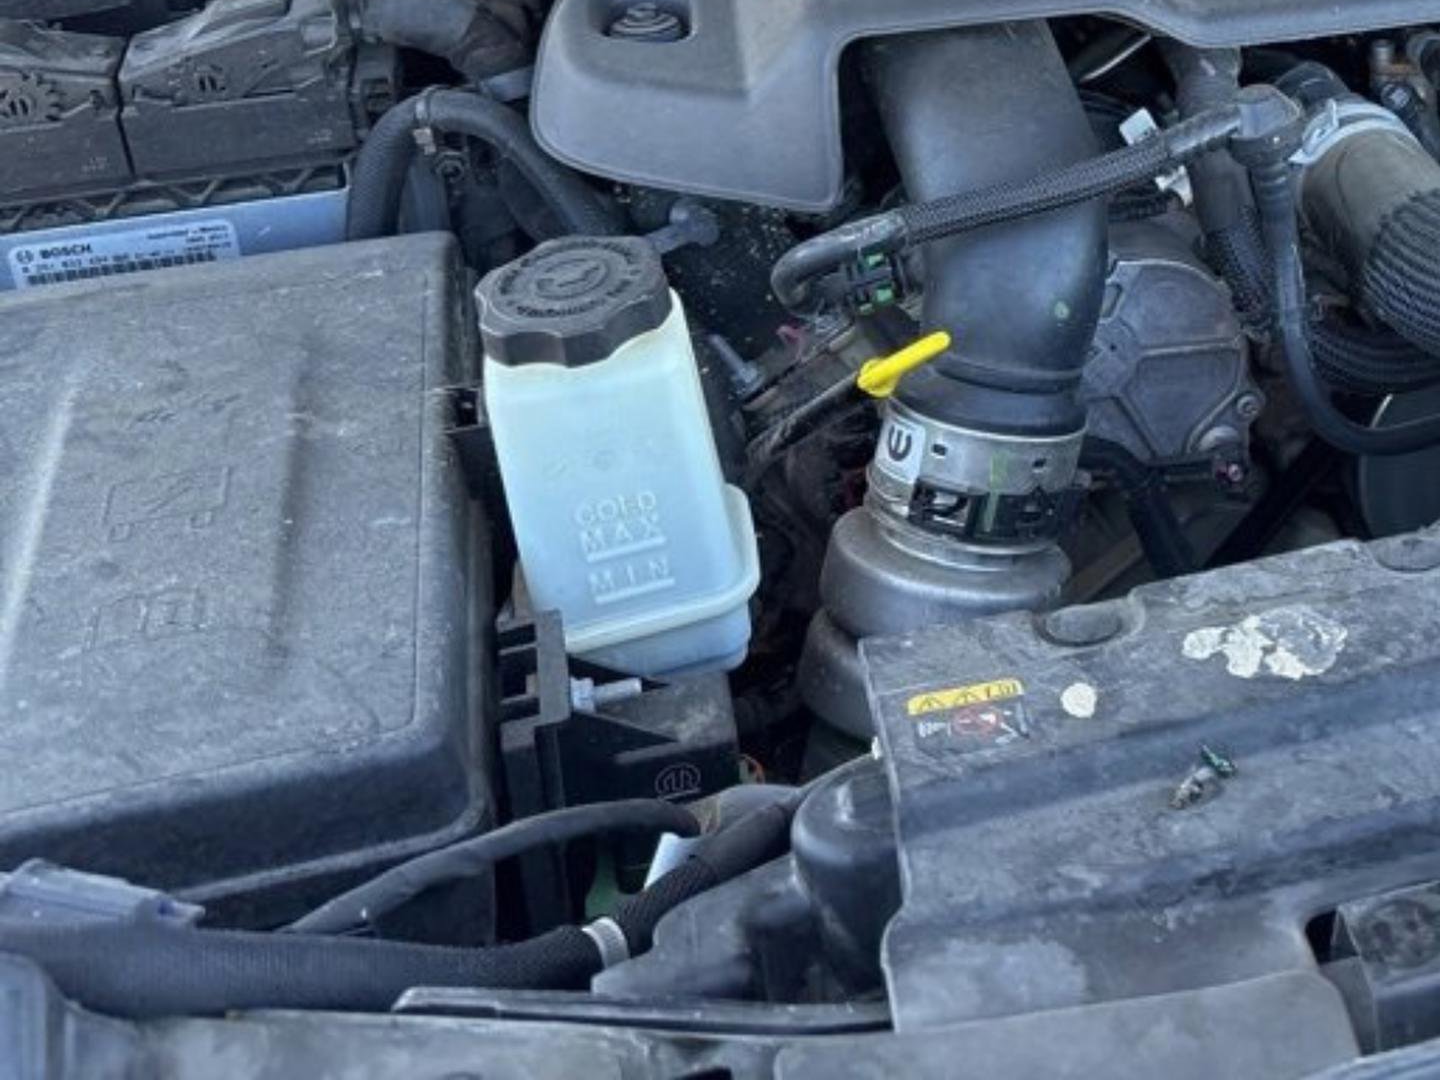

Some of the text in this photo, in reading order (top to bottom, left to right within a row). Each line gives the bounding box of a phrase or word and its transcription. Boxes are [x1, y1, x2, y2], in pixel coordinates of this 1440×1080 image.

[39, 243, 93, 260] BOSCH
[575, 490, 657, 526] COLD
[580, 512, 662, 553] MAX
[588, 556, 668, 595] MIN
